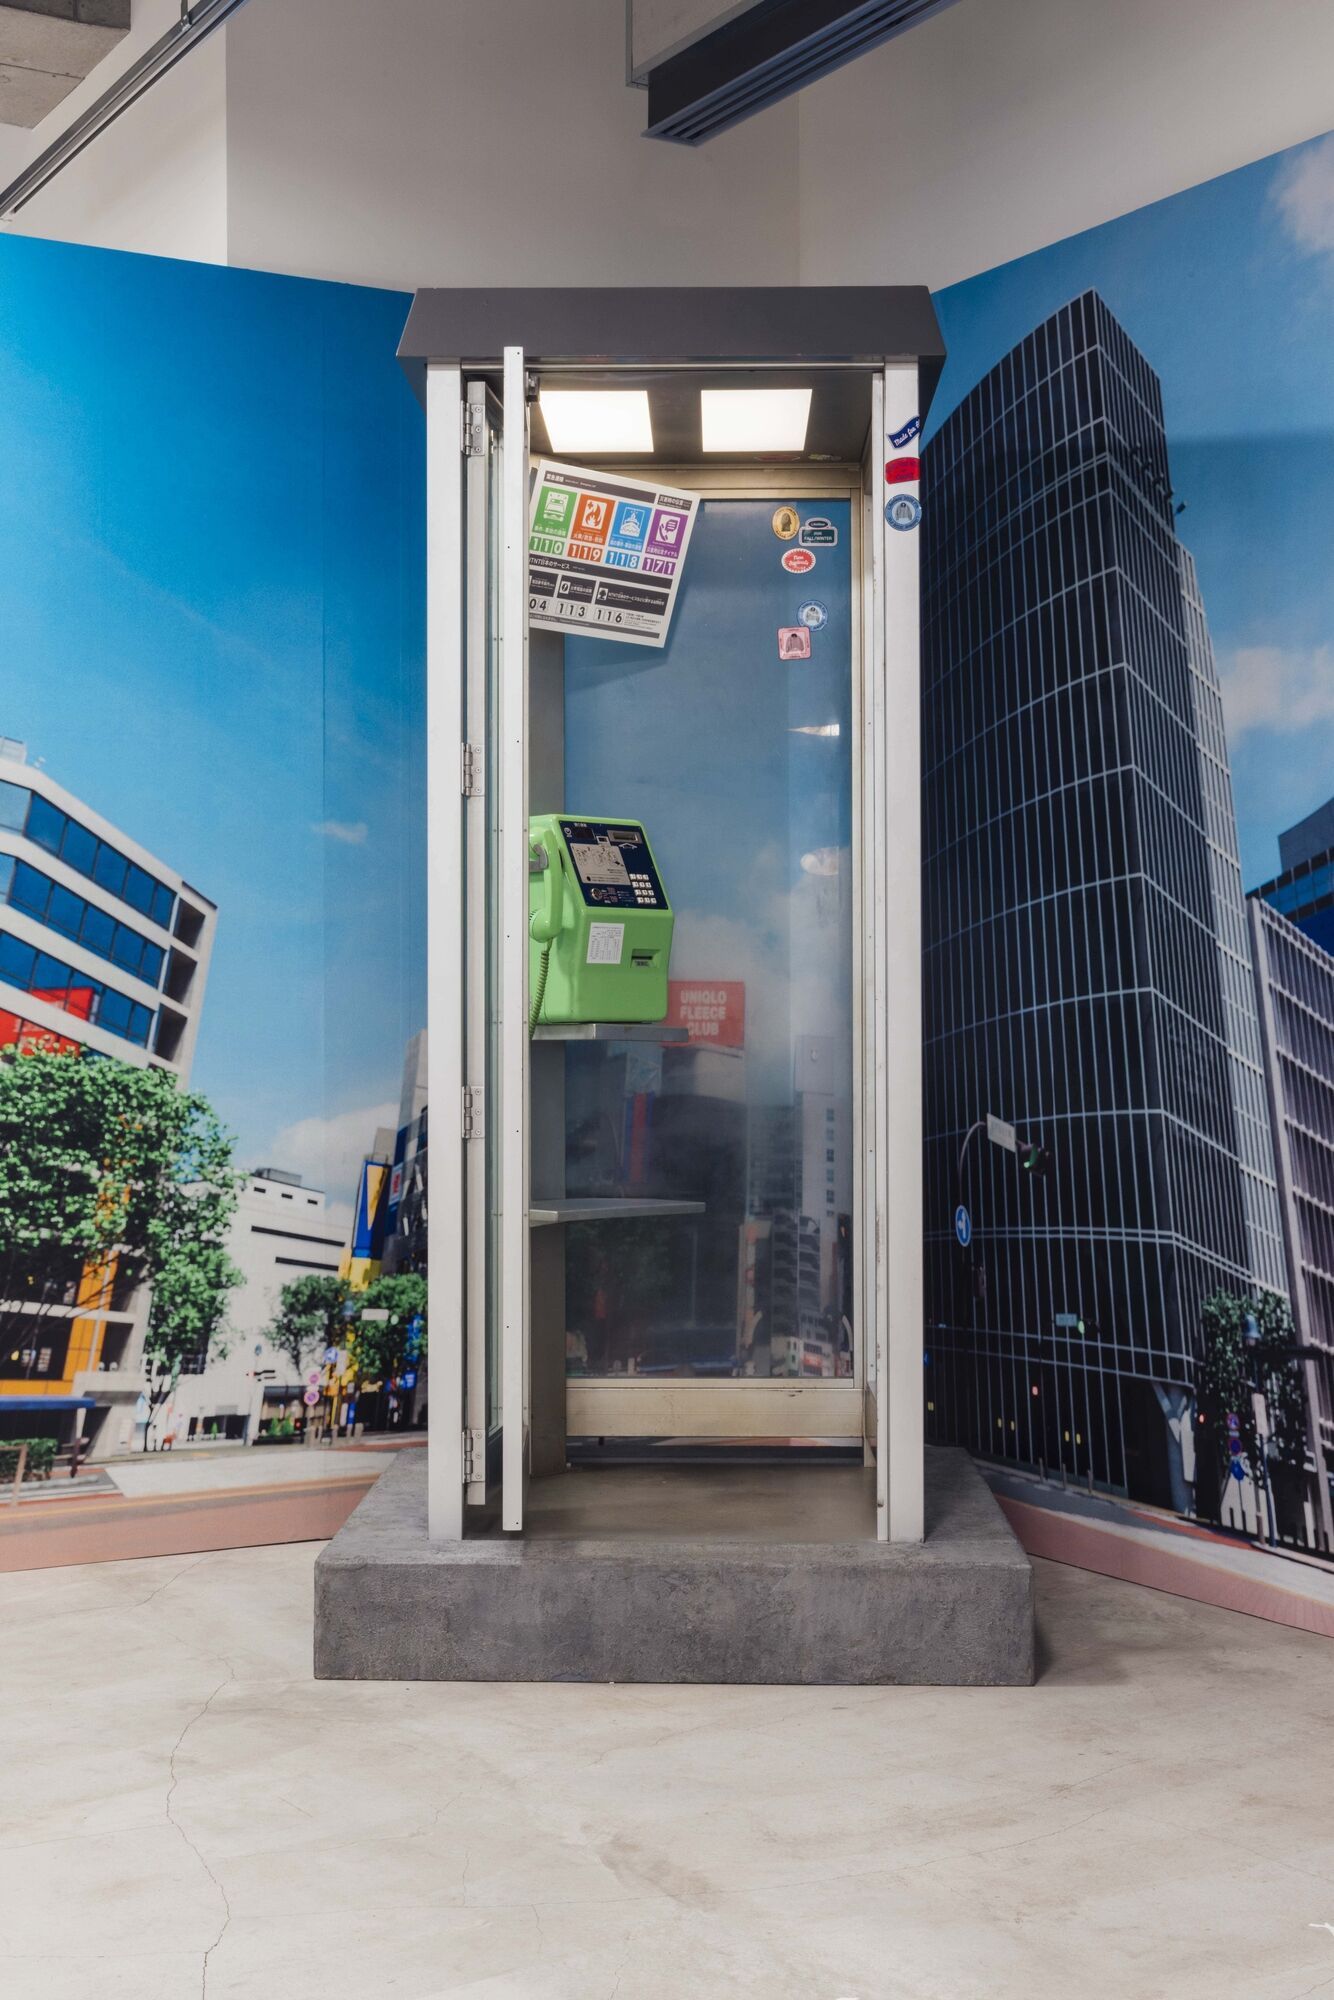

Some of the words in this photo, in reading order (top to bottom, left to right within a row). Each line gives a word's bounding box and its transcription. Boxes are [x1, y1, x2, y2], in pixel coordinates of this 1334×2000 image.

[533, 538, 562, 554] 110
[572, 545, 601, 561] 119
[609, 552, 637, 568] 118
[646, 558, 674, 574] 171
[559, 603, 585, 617] 113
[597, 609, 622, 623] 116
[680, 990, 727, 1004] UNIQLO
[680, 1006, 726, 1020] FLEECE
